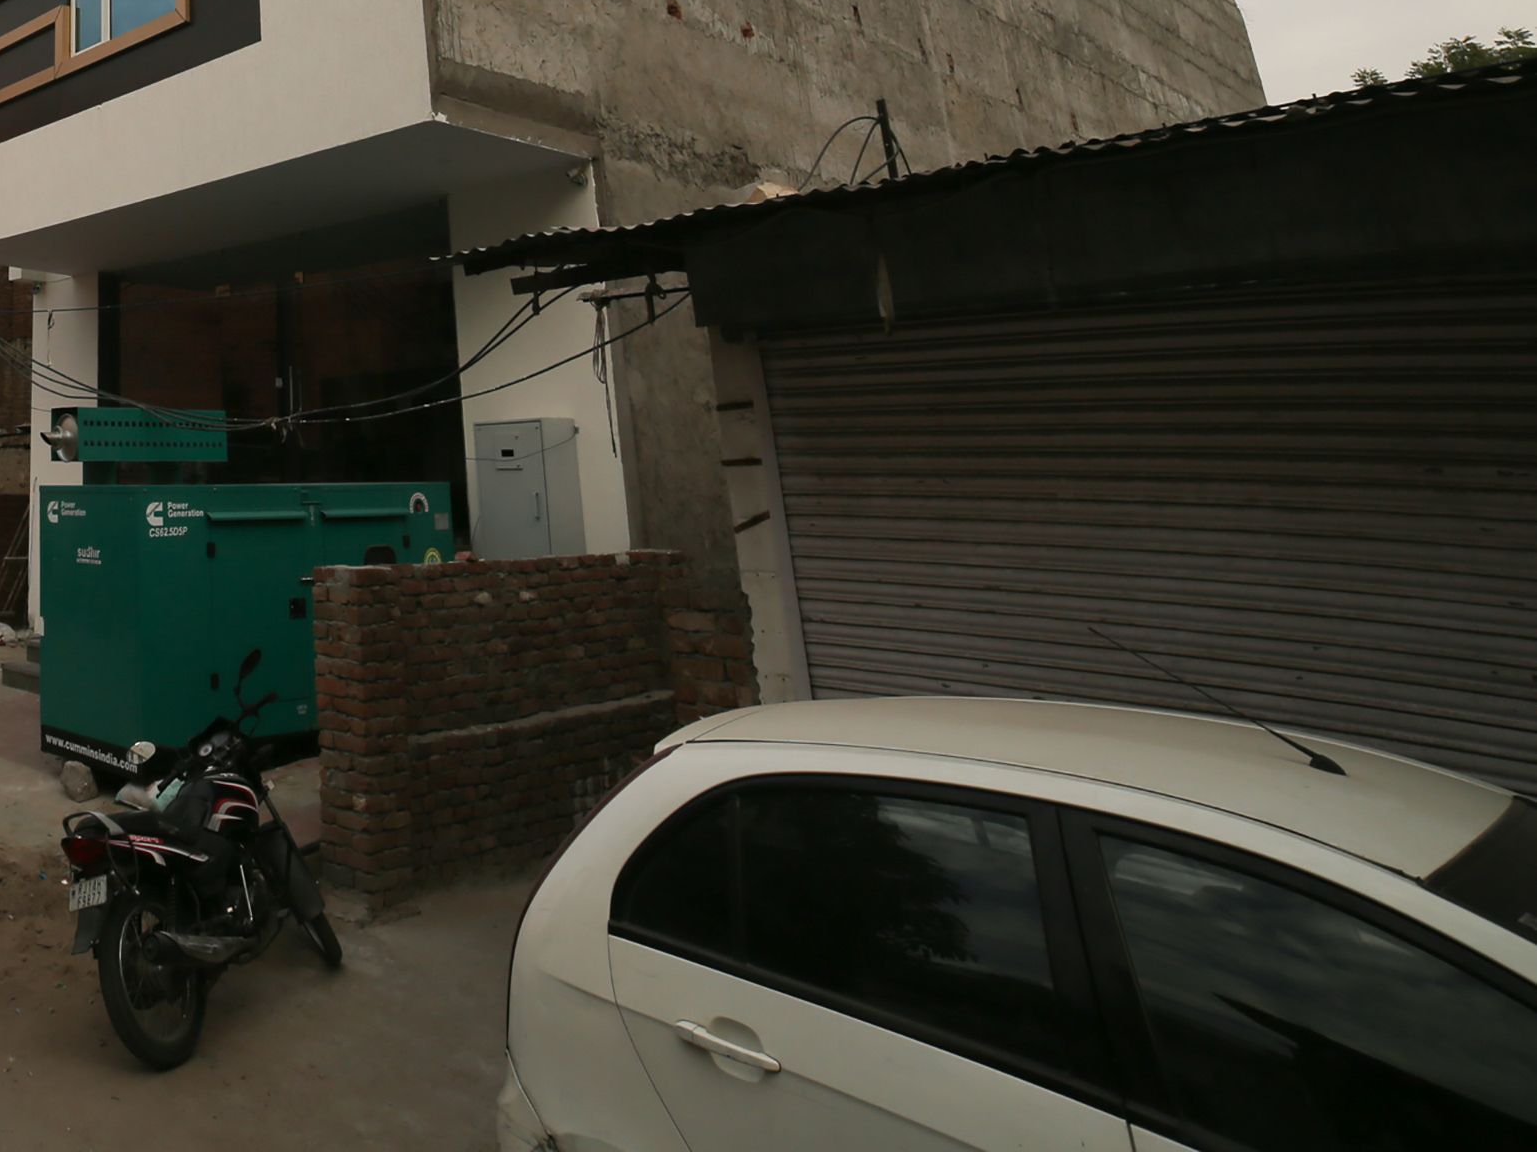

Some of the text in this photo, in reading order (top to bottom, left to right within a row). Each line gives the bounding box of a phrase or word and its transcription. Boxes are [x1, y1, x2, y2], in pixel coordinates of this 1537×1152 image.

[60, 500, 77, 509] Power
[167, 501, 189, 511] Power
[60, 508, 87, 517] Generation
[167, 509, 205, 519] Generation
[45, 733, 138, 774] www.cumminsindia.com
